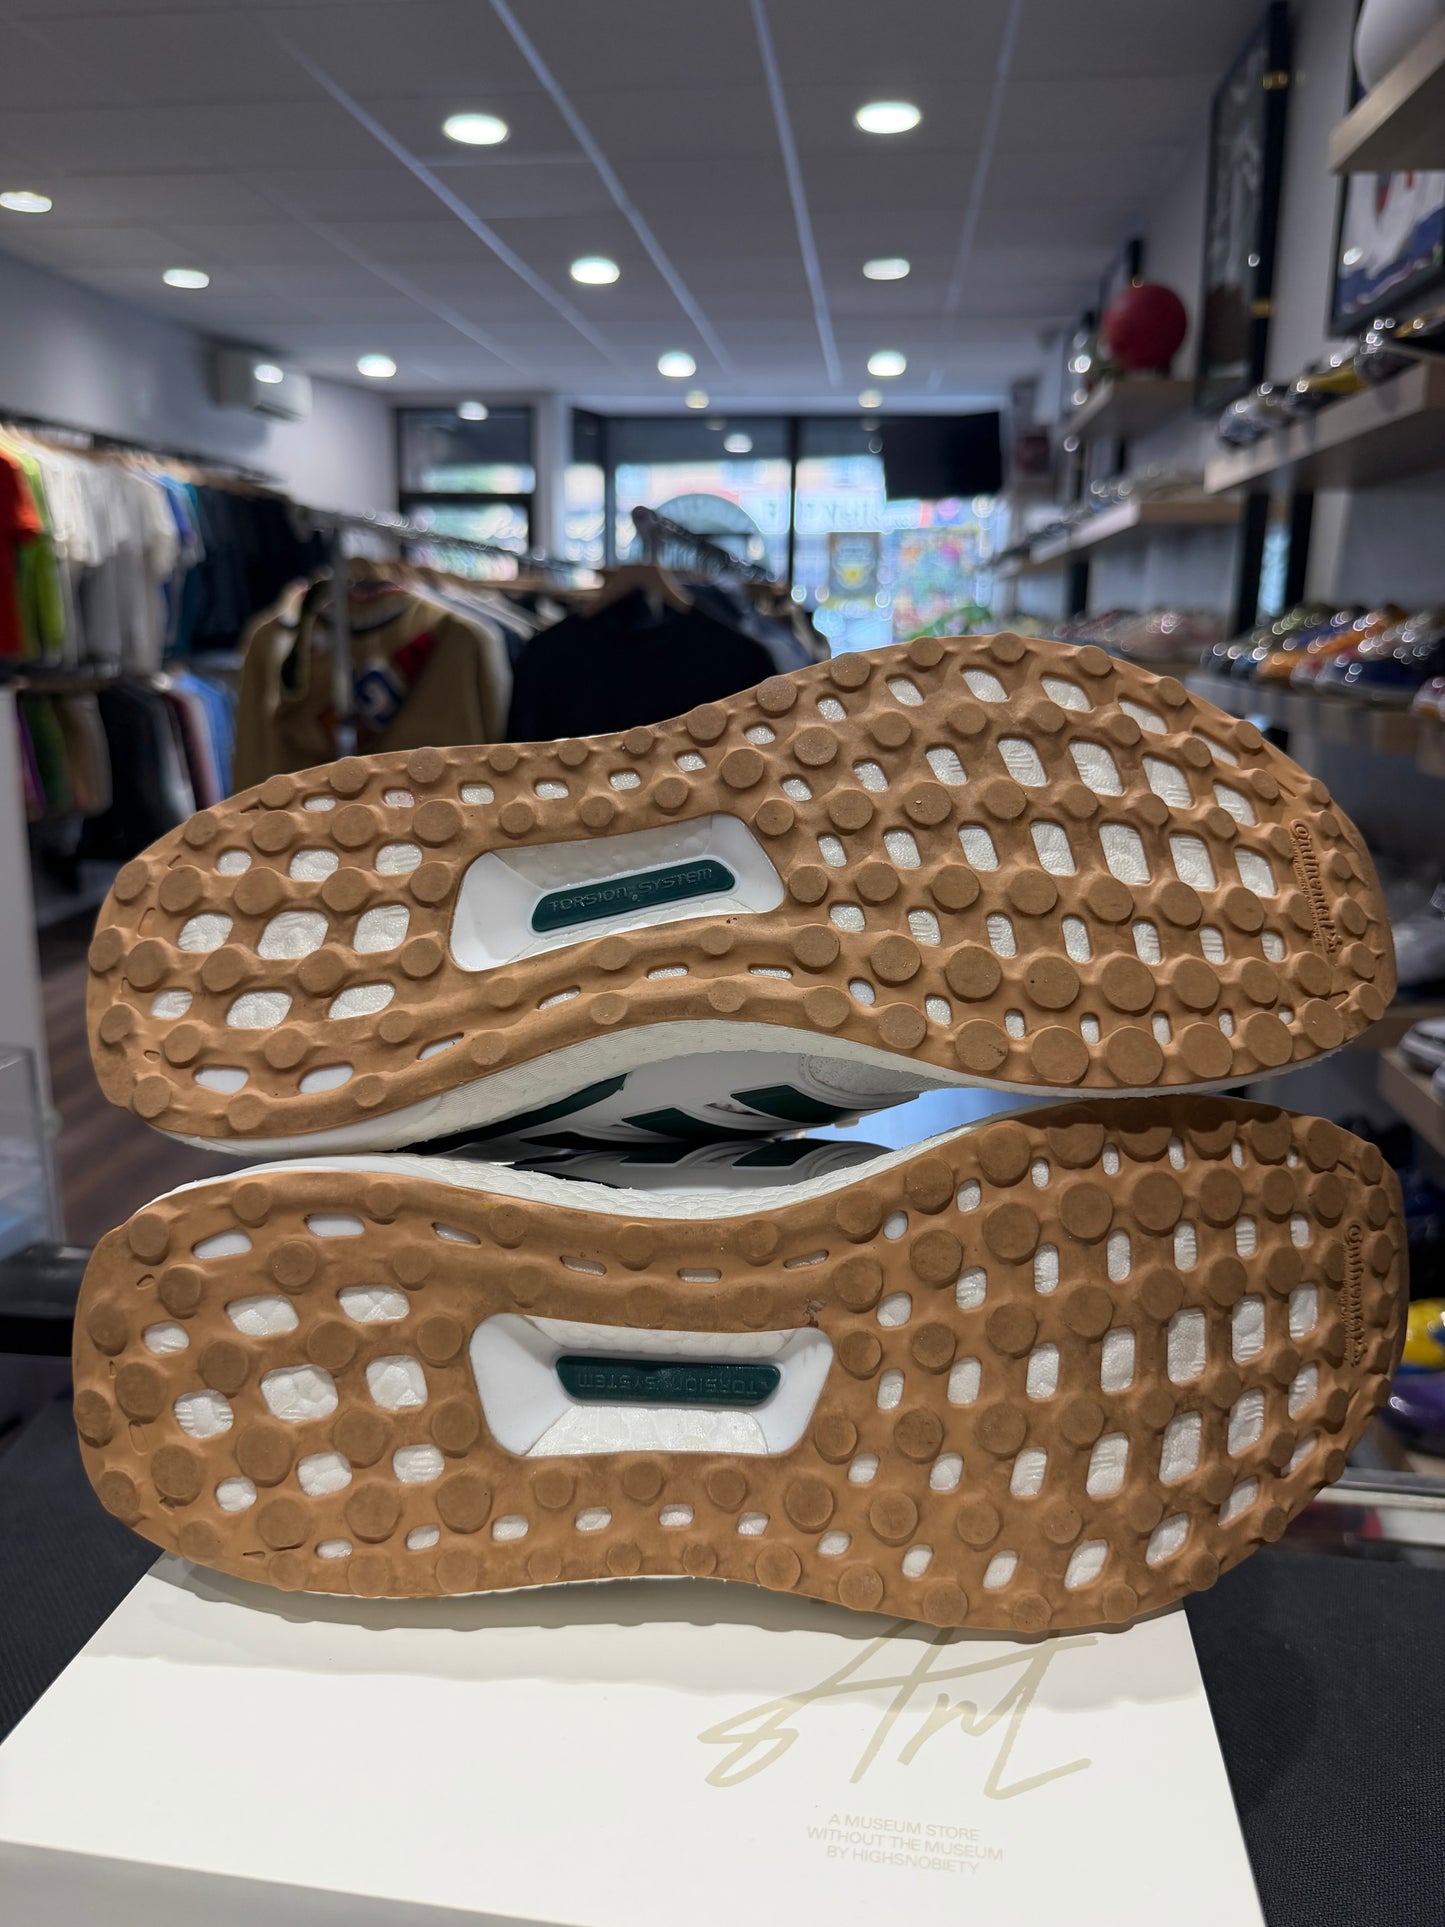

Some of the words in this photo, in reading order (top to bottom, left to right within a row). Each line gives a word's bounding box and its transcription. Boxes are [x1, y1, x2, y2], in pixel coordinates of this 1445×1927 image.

[828, 1813, 841, 1826] A
[844, 1815, 922, 1835] MUSEUM
[926, 1824, 981, 1842] STORE
[806, 1825, 886, 1847] WITHOUT
[891, 1835, 921, 1852] THE
[924, 1839, 1004, 1862] MUSEUM
[826, 1845, 849, 1859] BY
[852, 1848, 980, 1875] HIGHSNOBIETY
